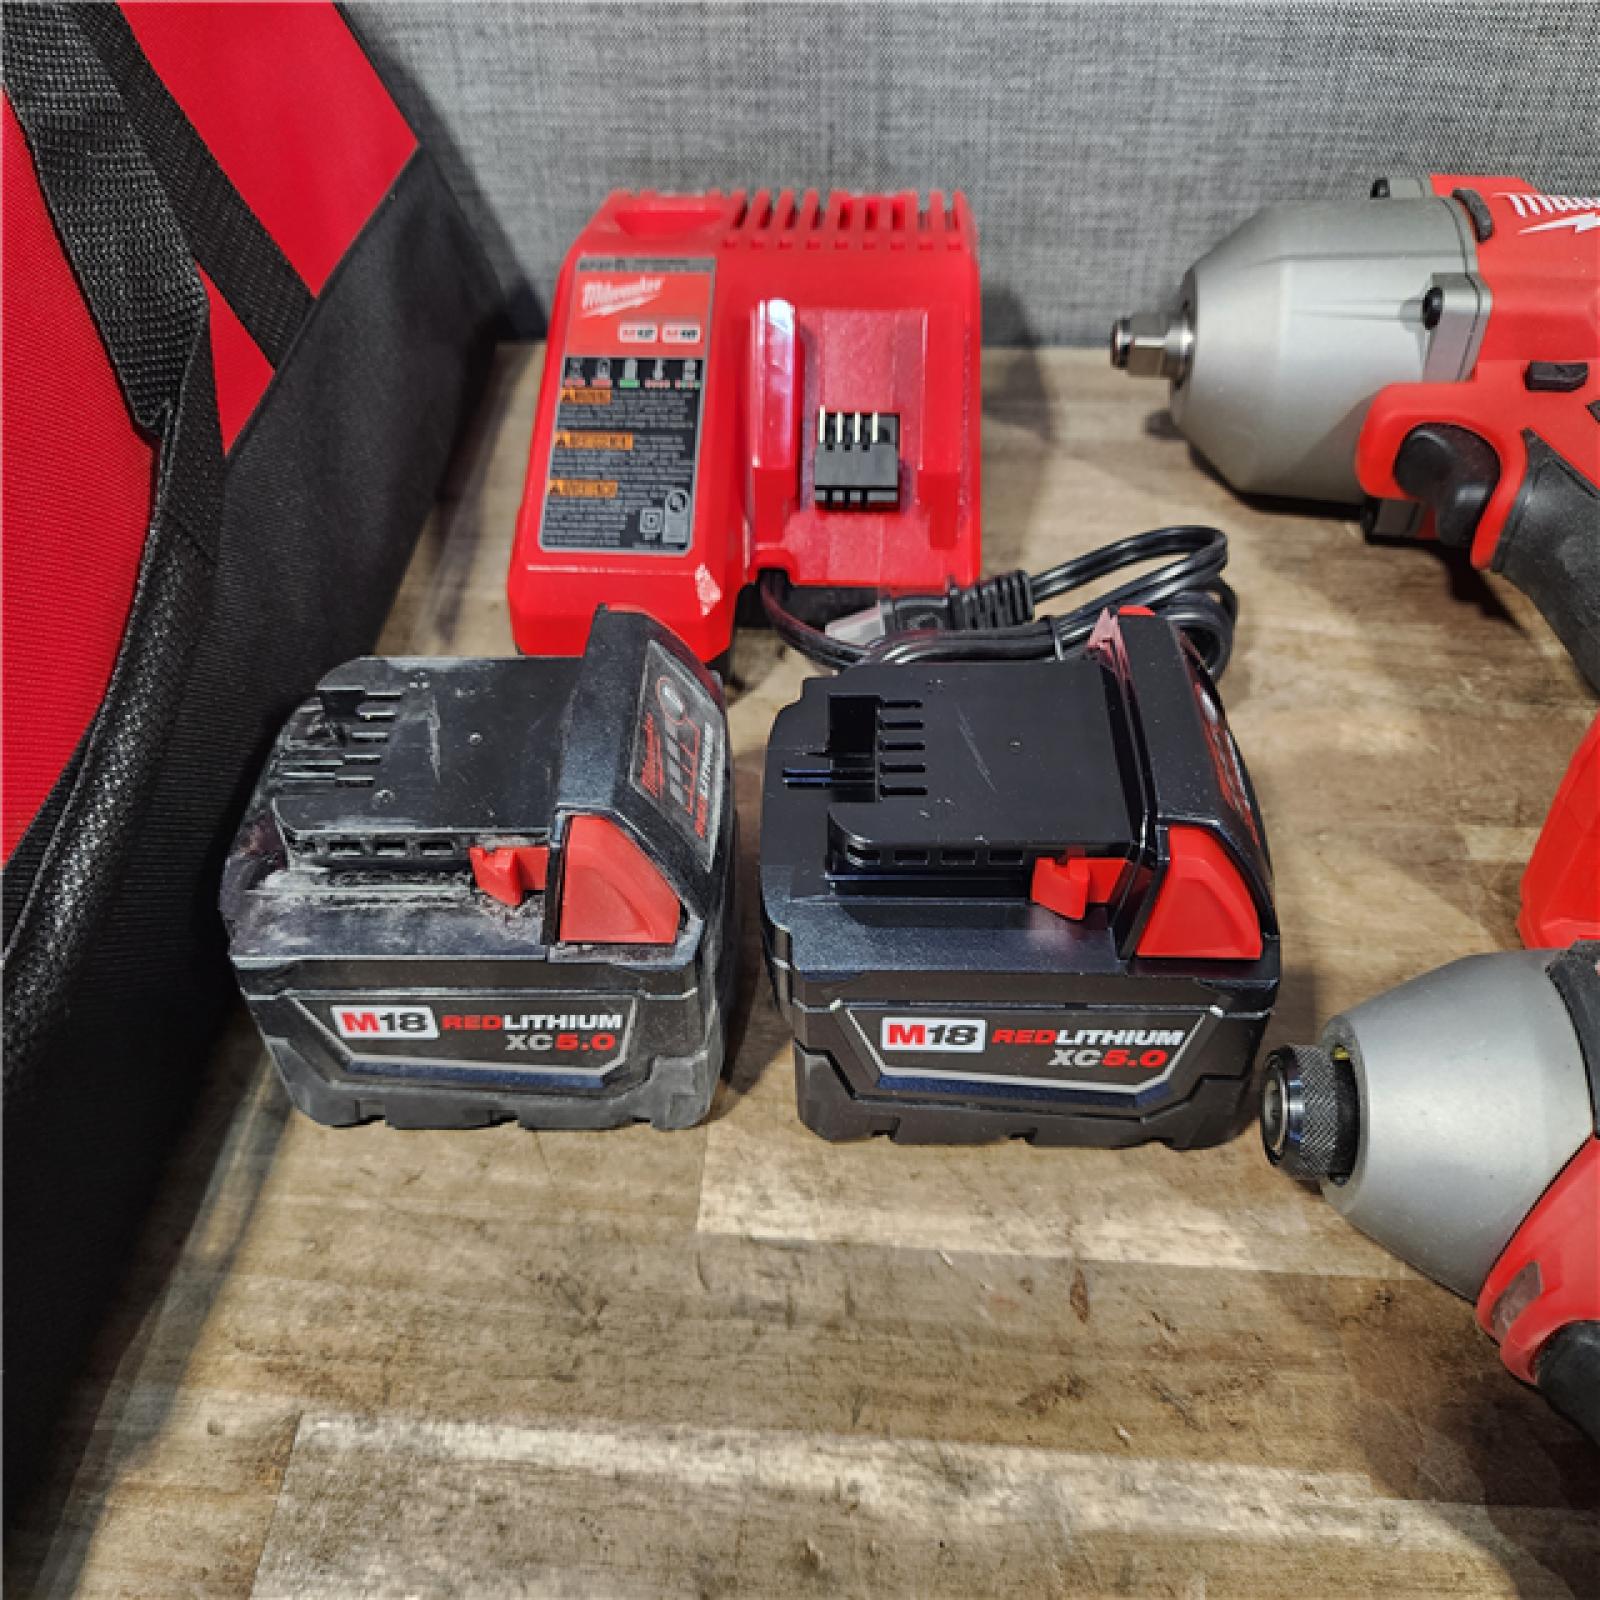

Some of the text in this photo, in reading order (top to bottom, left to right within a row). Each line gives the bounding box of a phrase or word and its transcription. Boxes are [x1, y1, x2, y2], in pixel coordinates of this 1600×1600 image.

[341, 1012, 623, 1034] M18 REDLITHIUM
[505, 1033, 616, 1051] XC5.0
[887, 1024, 1186, 1046] M18 REDLITHIUM
[1048, 1049, 1169, 1067] XC5.0
